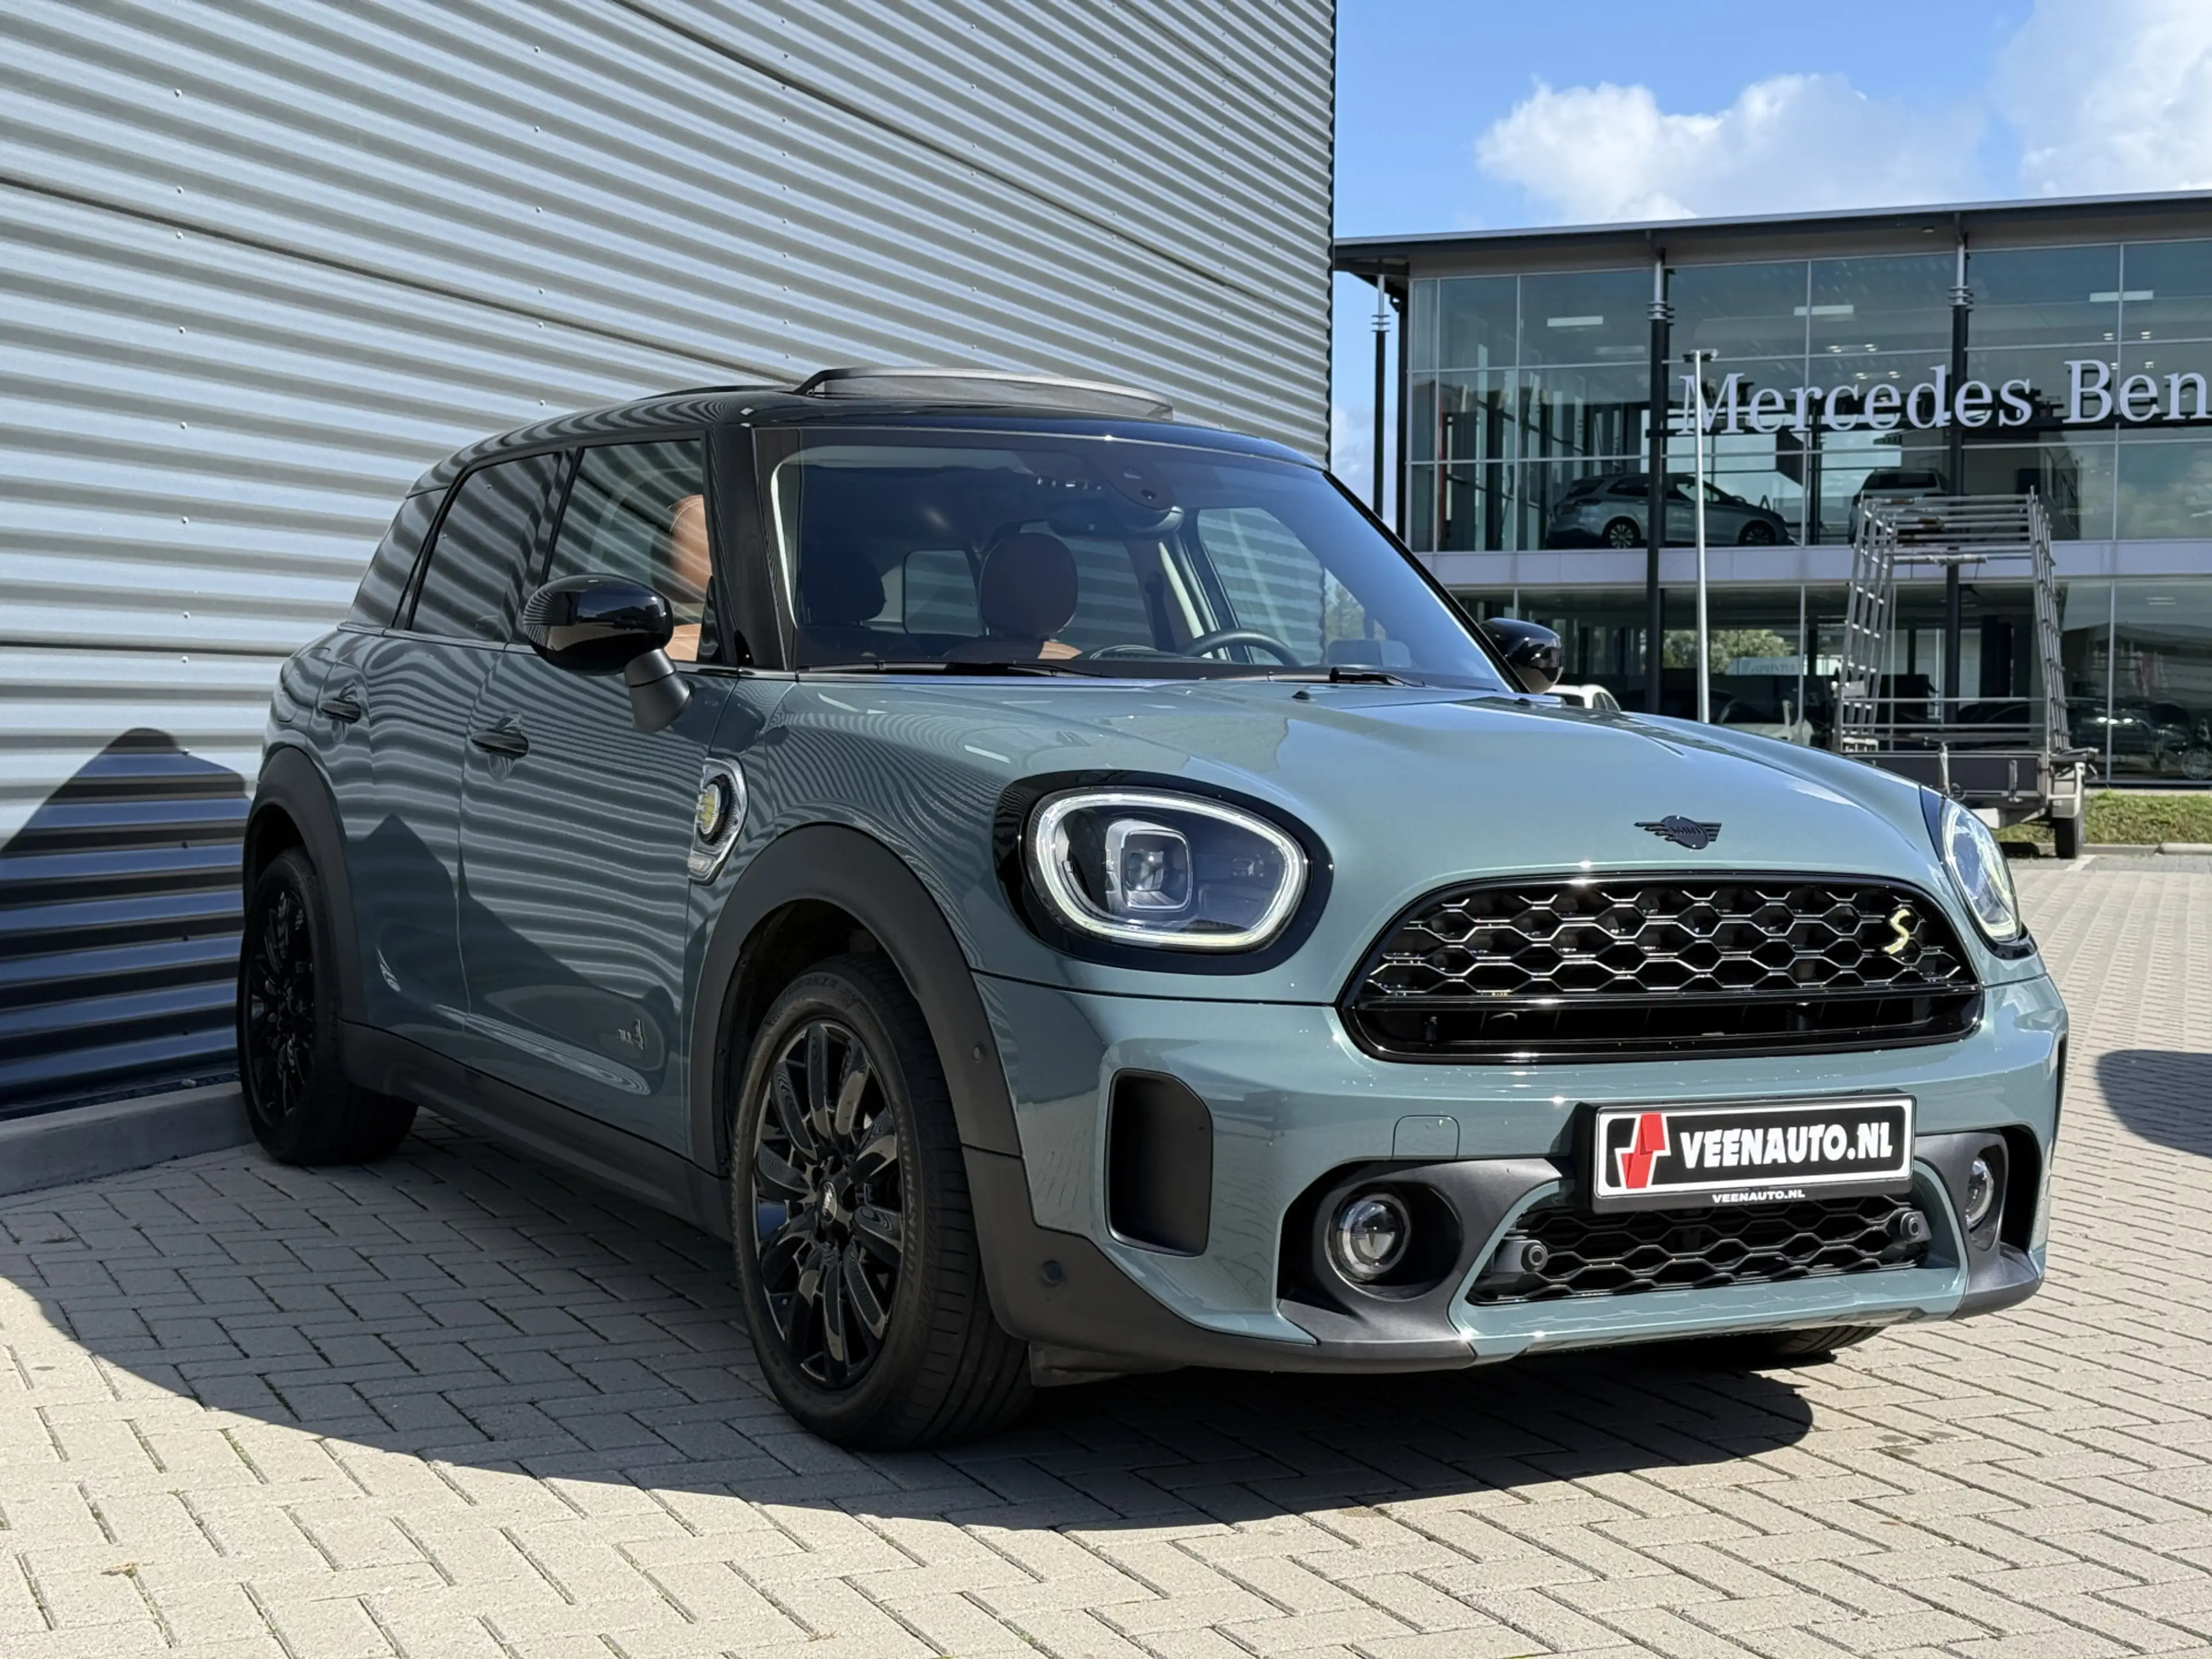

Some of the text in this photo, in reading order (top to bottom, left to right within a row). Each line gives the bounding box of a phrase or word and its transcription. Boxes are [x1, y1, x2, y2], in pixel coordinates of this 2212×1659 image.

[1675, 359, 2212, 435] Mercedes Ben
[1884, 909, 1911, 955] S
[1680, 1122, 1893, 1169] VEENAUTO.NL
[1711, 1189, 1805, 1203] VEENAUTO.NL
